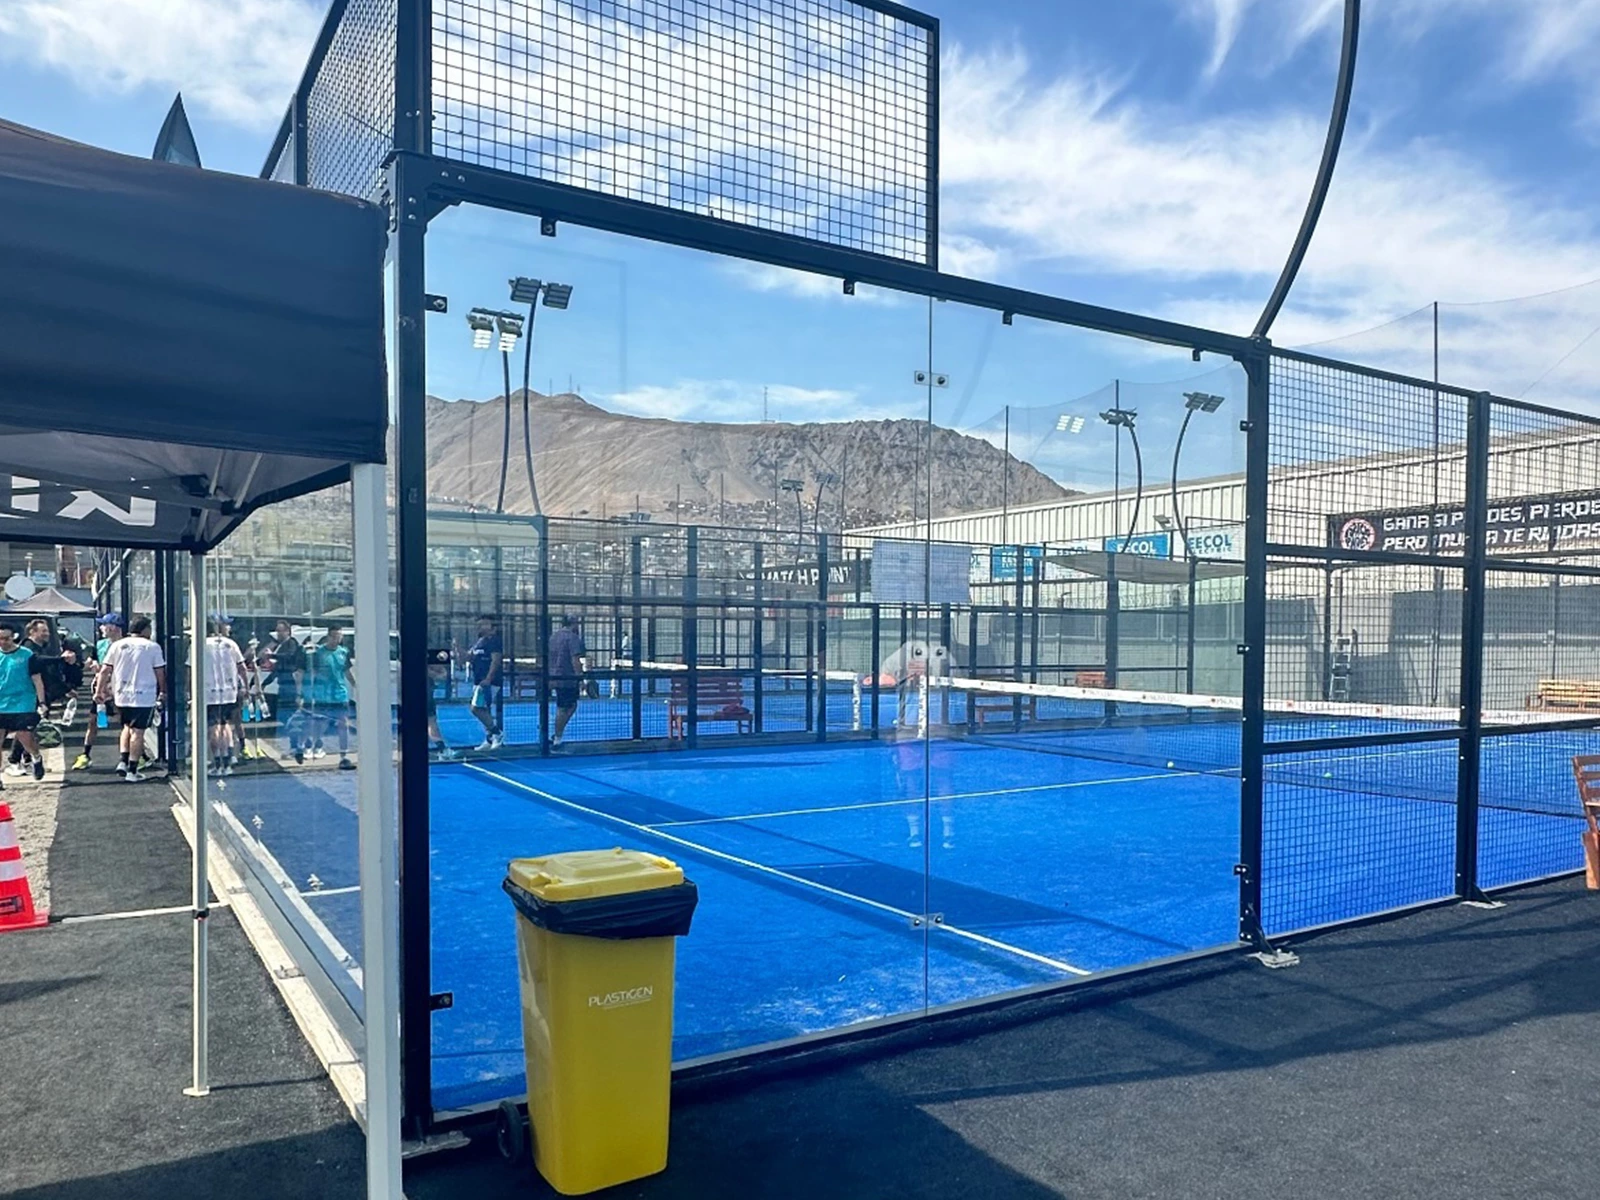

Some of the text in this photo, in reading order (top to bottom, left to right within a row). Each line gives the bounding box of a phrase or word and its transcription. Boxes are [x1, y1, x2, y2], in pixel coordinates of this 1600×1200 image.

[1383, 514, 1430, 531] GANA
[1381, 535, 1428, 551] PERO
[1503, 528, 1525, 543] TE
[588, 985, 653, 1007] PLASTIGEN
